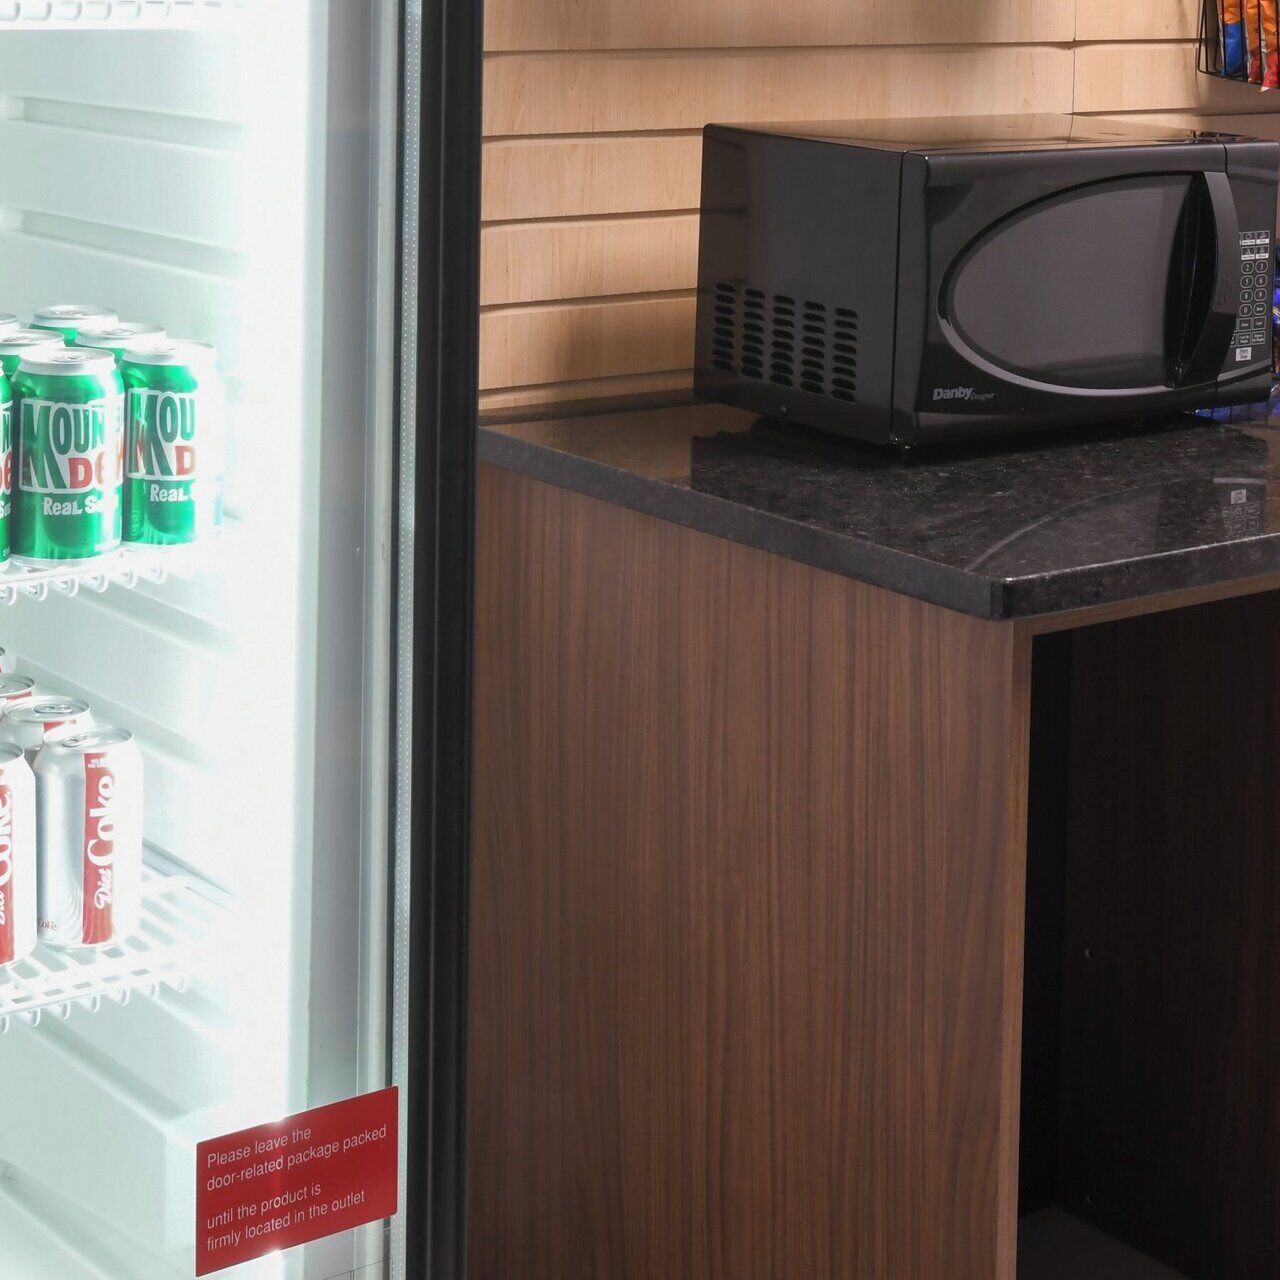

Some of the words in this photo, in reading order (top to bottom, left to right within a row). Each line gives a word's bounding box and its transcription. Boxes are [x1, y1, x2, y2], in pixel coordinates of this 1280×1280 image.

[932, 387, 974, 401] Danby
[87, 775, 115, 867] Coke
[93, 867, 113, 910] Diet
[207, 1144, 251, 1169] Please
[255, 1135, 289, 1154] leave
[292, 1128, 313, 1144] the
[207, 1156, 285, 1192] door-related
[287, 1139, 340, 1170] package
[343, 1124, 388, 1154] packed
[207, 1206, 234, 1231] until
[237, 1204, 258, 1222] the
[261, 1186, 308, 1216] product
[310, 1181, 322, 1197] is
[207, 1230, 242, 1253] firmly
[245, 1212, 292, 1240] located
[294, 1210, 306, 1224] in
[309, 1202, 329, 1220] the
[331, 1188, 366, 1212] outlet
